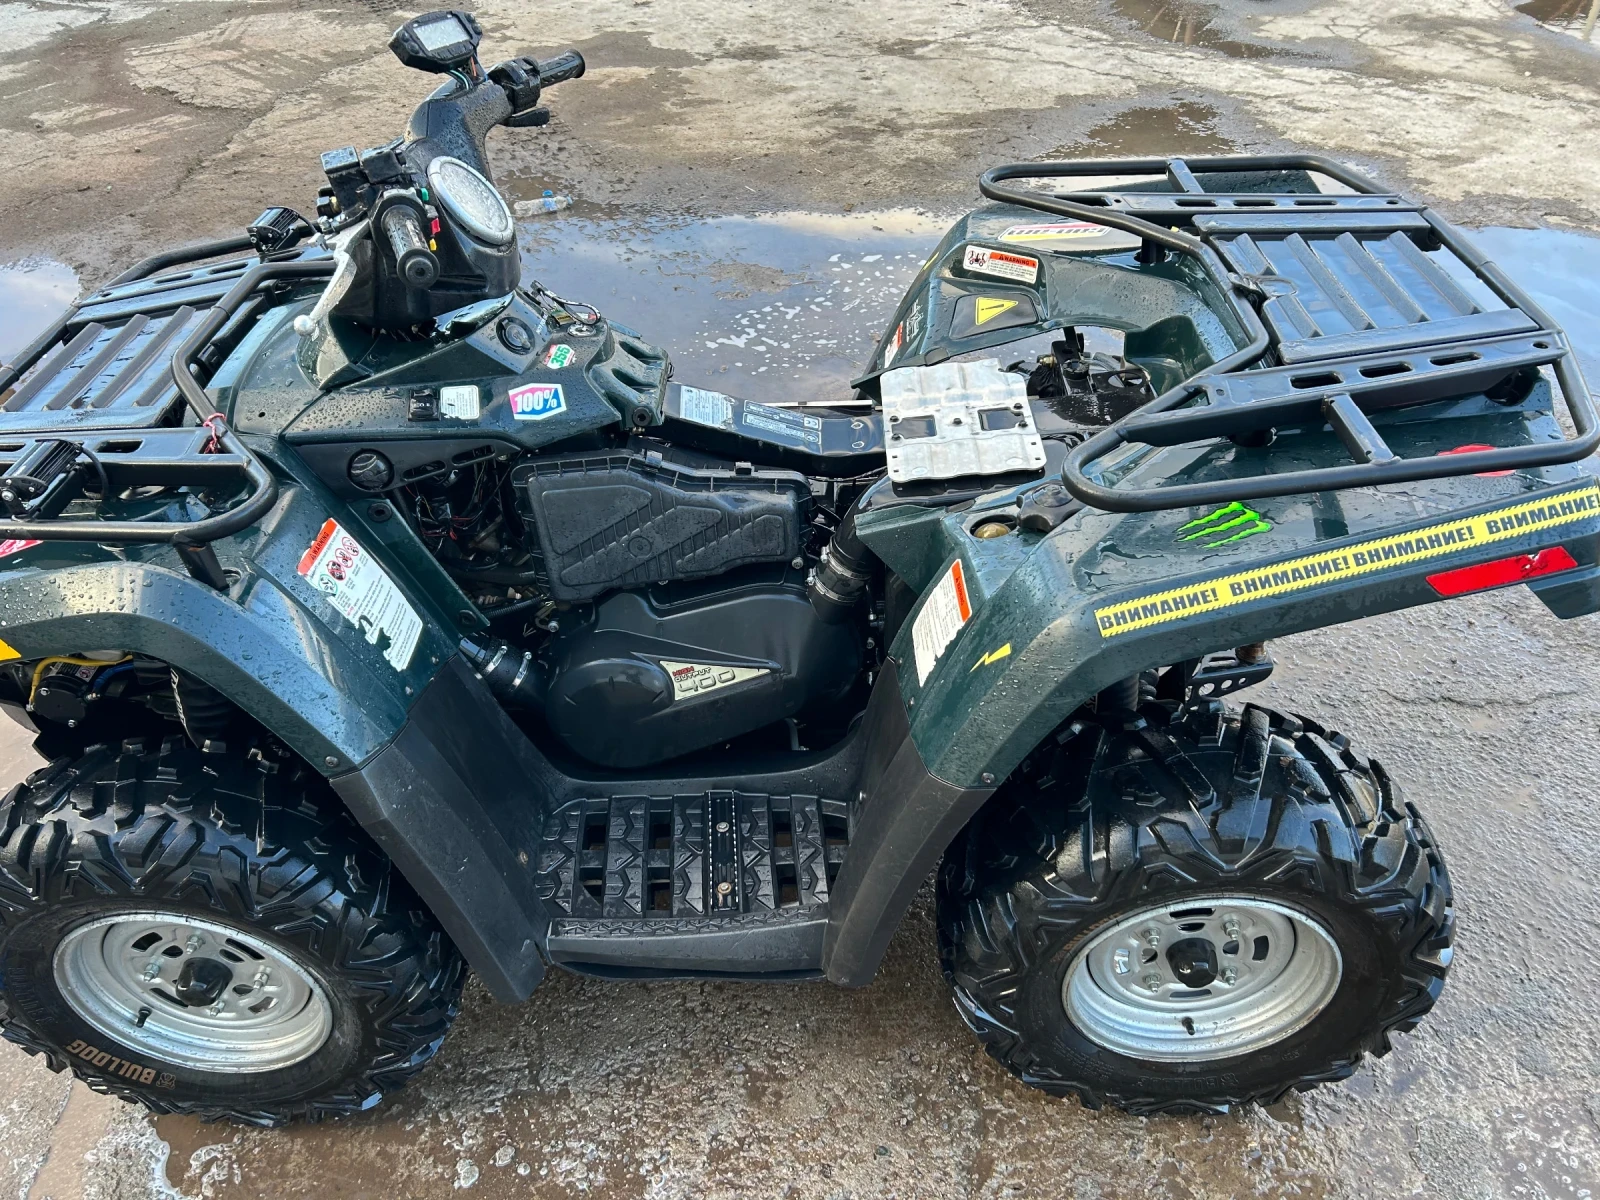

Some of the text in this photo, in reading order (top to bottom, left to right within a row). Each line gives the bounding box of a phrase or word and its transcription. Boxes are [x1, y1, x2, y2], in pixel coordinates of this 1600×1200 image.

[1004, 255, 1030, 265] WARNING
[550, 345, 571, 367] 355
[514, 388, 558, 413] 100%
[312, 531, 330, 556] WARNING
[1100, 587, 1219, 630] ВНИМАНИЕ!
[1229, 554, 1350, 597] ВНИМАНИЕ!
[1353, 525, 1475, 567] ВНИМАНИЕ!
[672, 666, 695, 677] HIGH
[674, 667, 712, 682] OUTPUT
[678, 669, 736, 692] 400
[65, 1039, 157, 1085] BULLDOG
